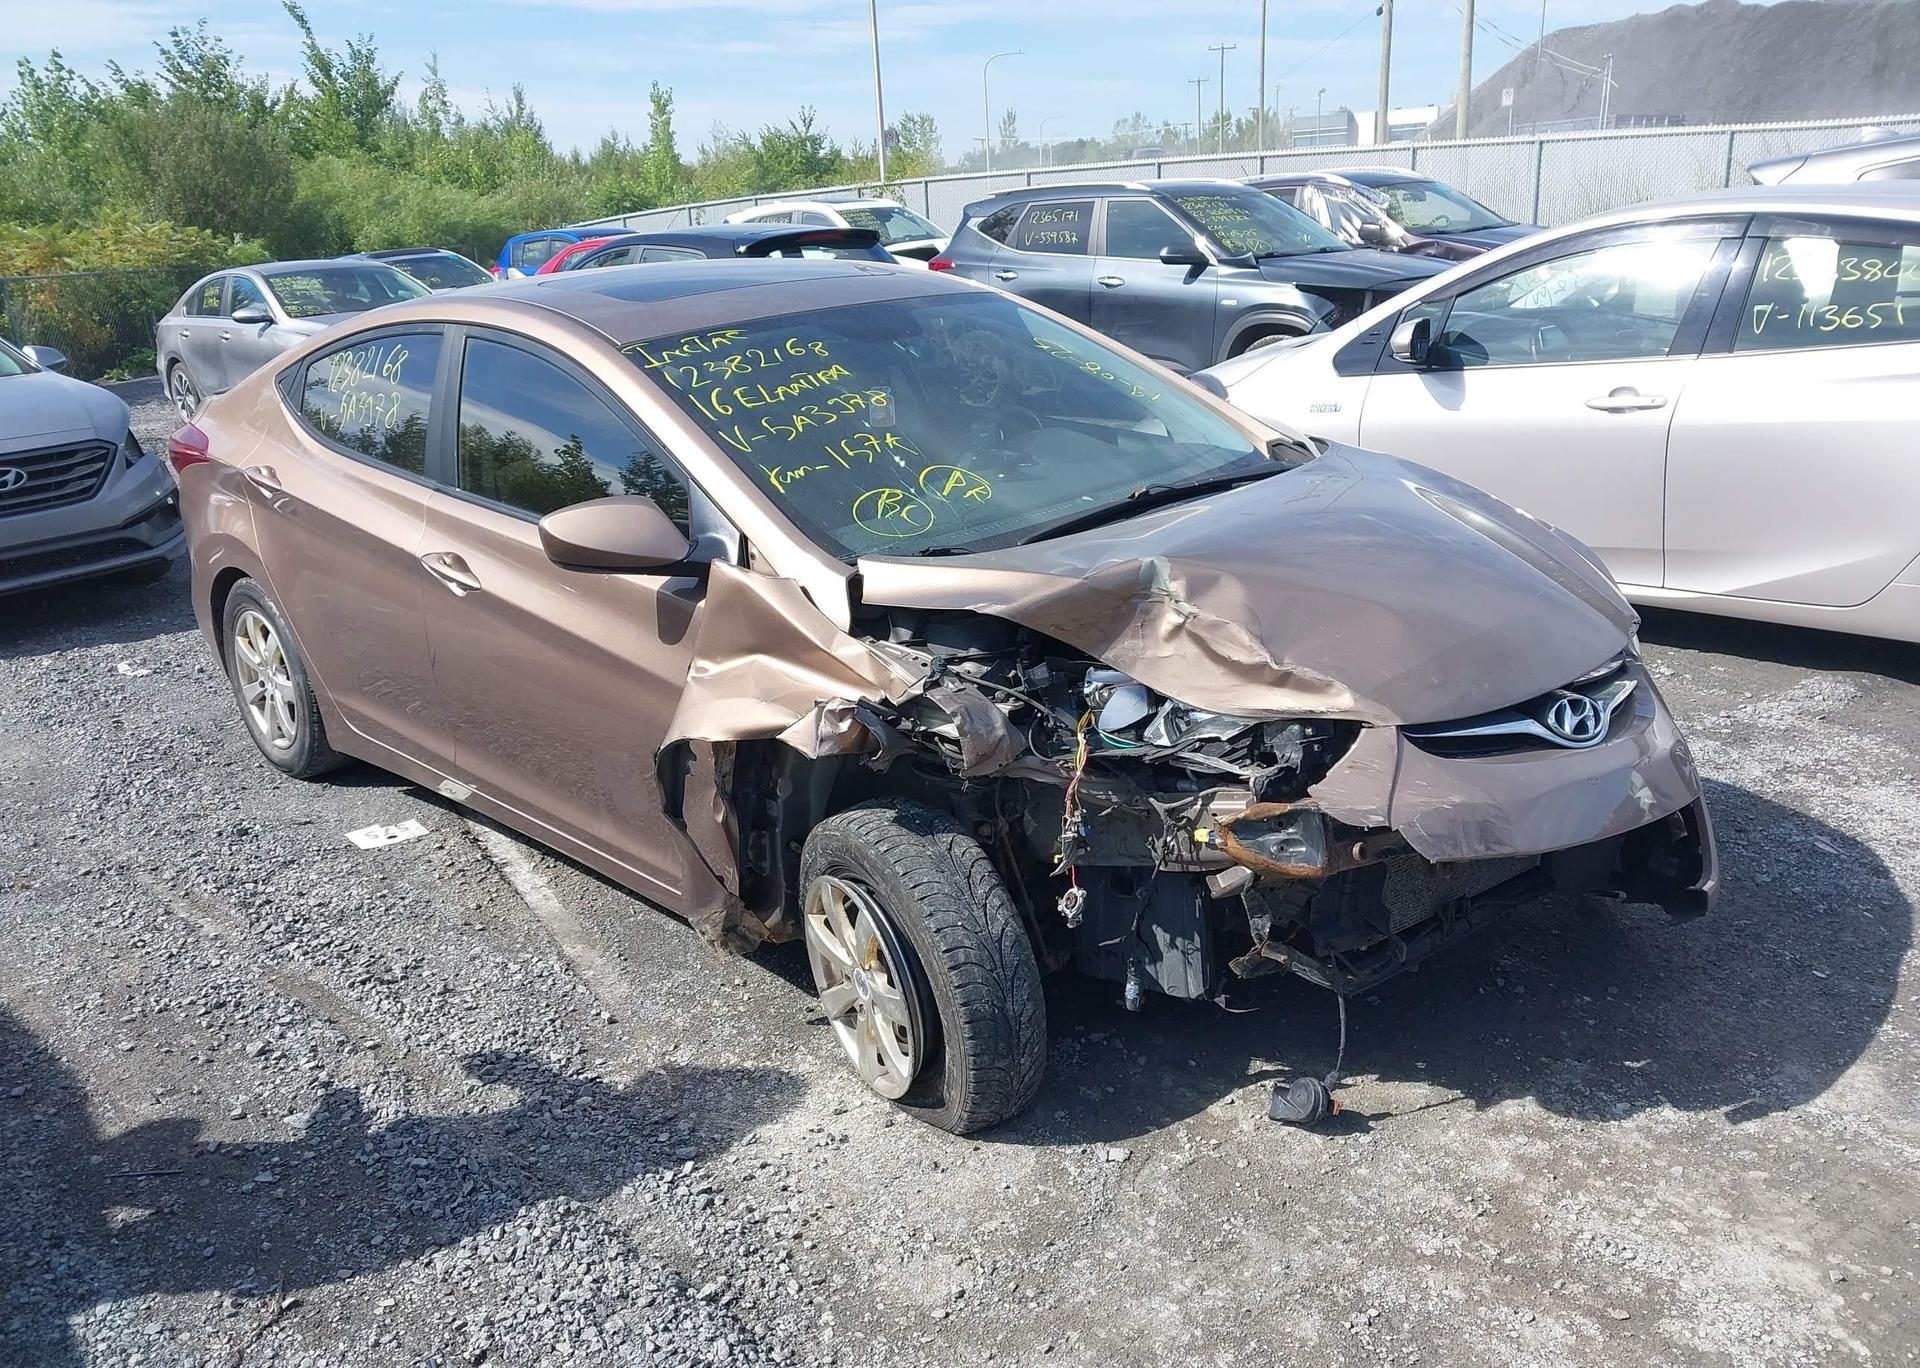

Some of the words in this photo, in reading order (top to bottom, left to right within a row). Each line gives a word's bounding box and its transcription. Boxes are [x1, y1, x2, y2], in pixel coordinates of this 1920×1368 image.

[1029, 209, 1079, 224] 12365171
[327, 343, 409, 393] 12382168
[663, 338, 829, 391] 12382168
[688, 387, 733, 421] 16
